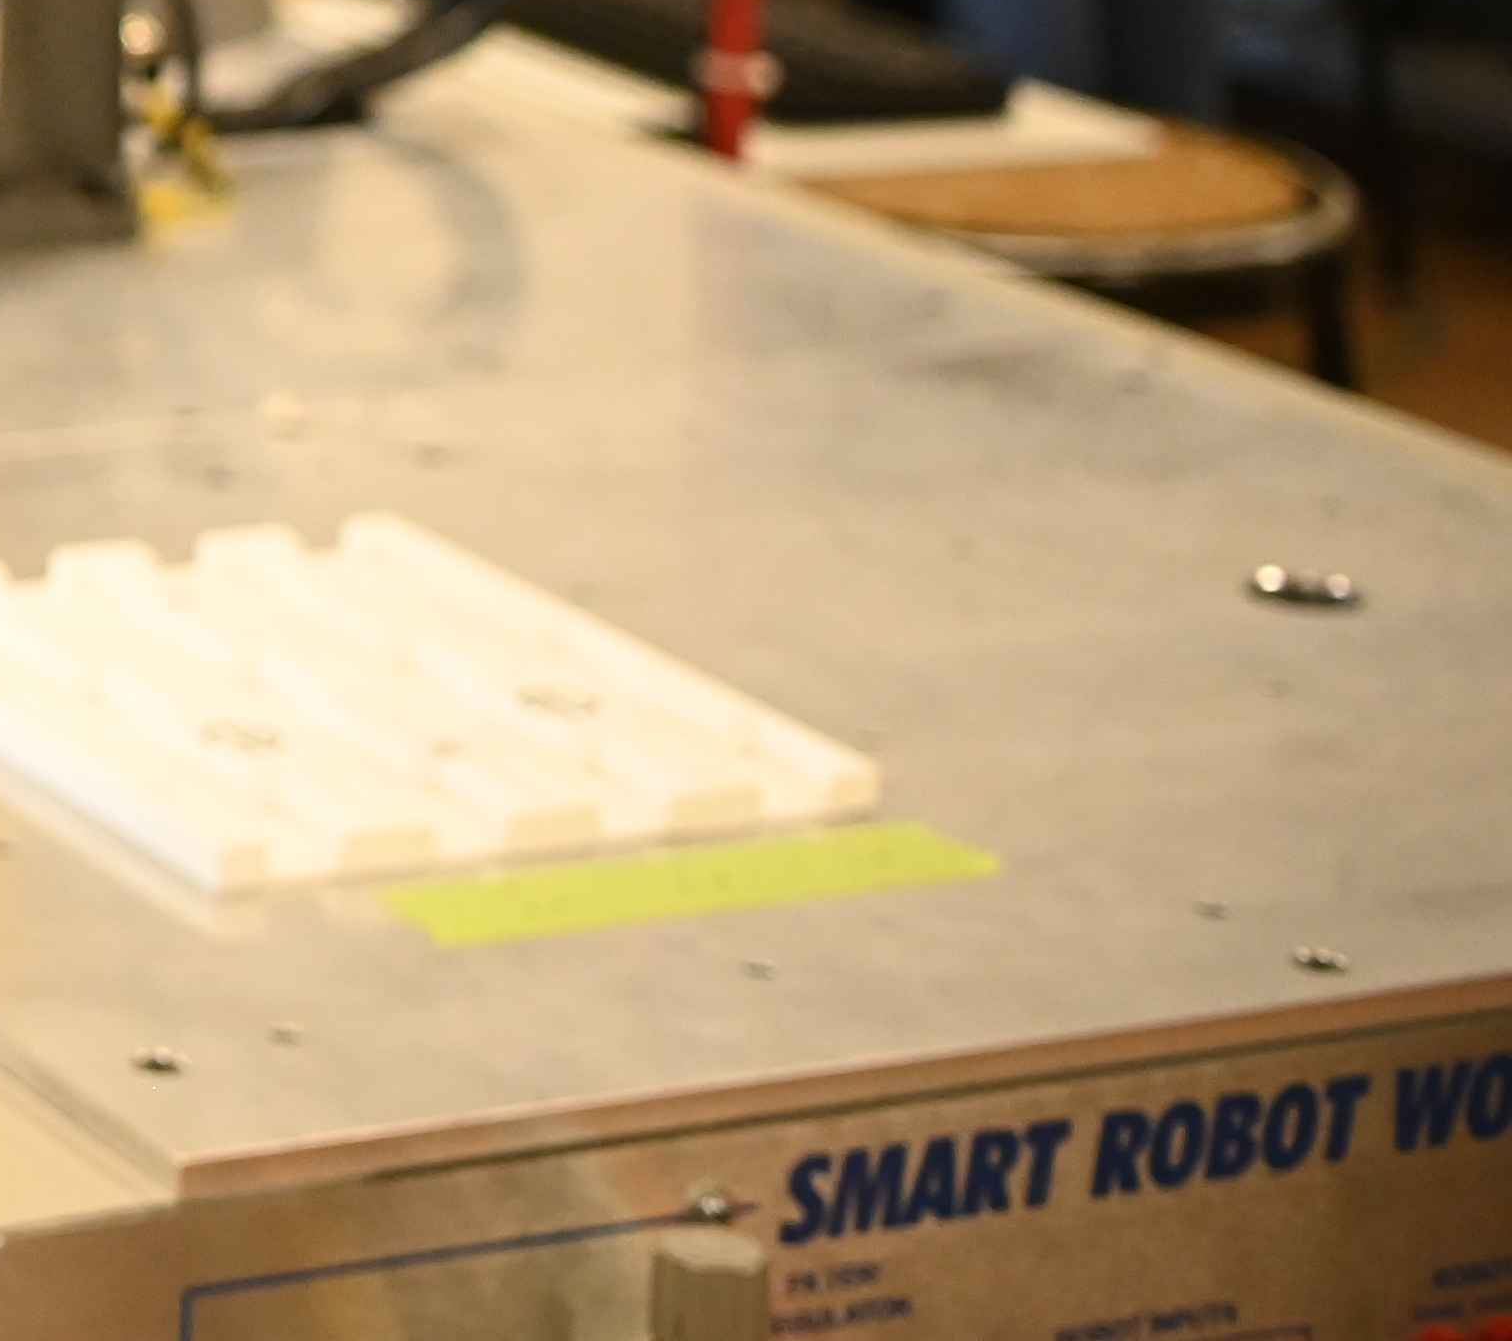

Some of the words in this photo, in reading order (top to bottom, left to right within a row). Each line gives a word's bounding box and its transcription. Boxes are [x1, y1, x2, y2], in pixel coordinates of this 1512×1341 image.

[779, 1120, 1072, 1246] SMART
[1090, 1074, 1371, 1200] ROBOT
[1394, 1052, 1512, 1153] WO
